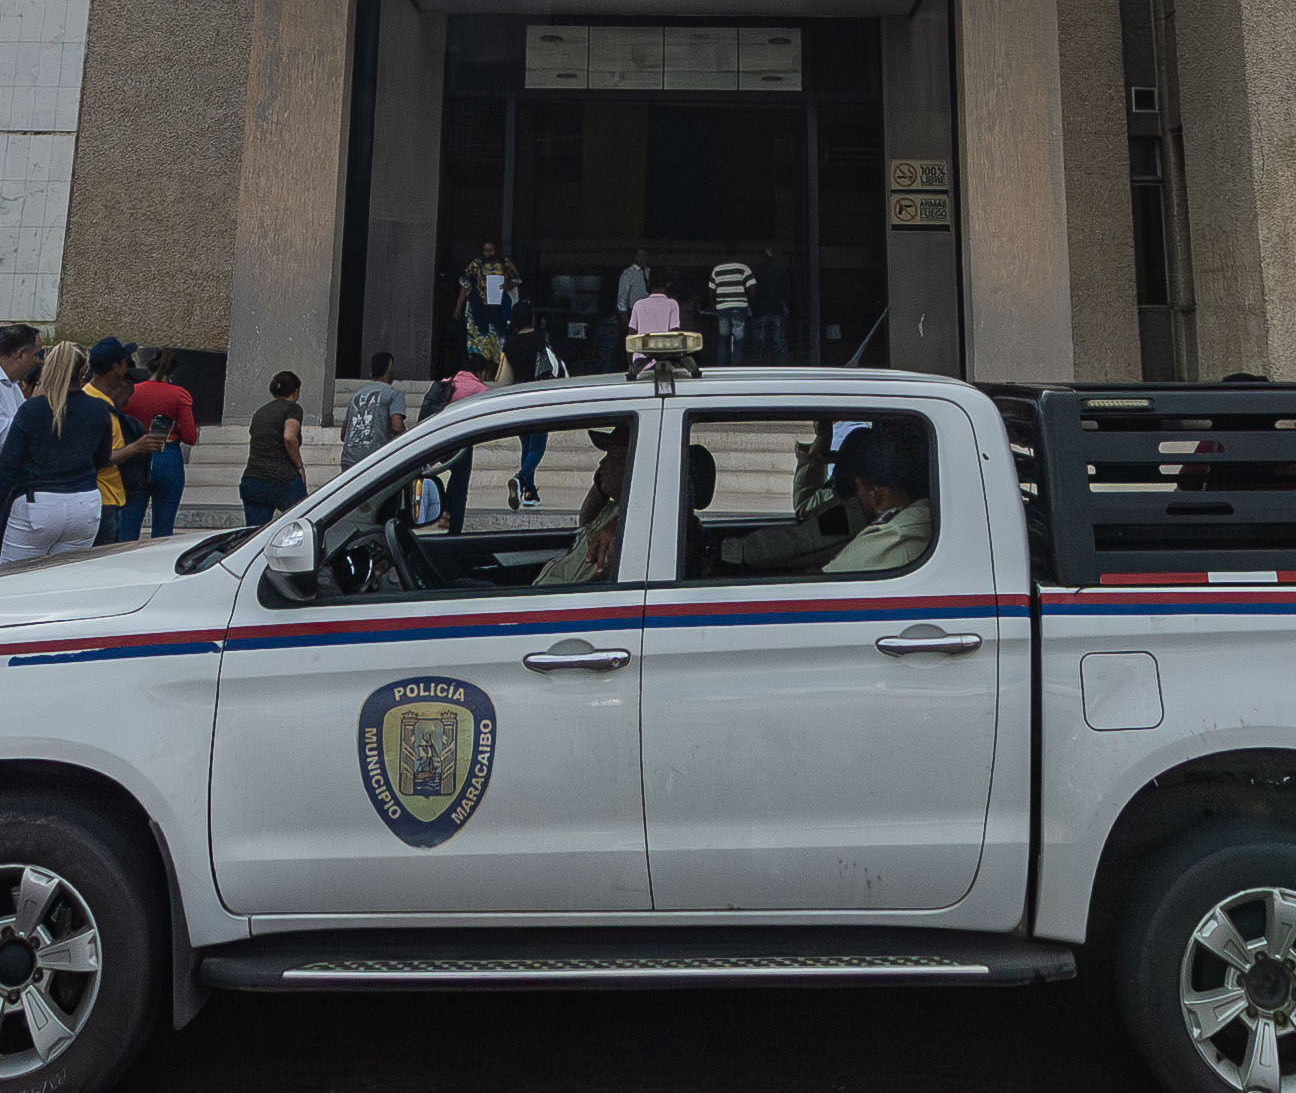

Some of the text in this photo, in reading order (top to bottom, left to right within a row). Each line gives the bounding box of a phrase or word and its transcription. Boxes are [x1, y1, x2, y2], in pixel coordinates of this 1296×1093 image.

[394, 683, 465, 702] POLICÍA
[365, 727, 401, 820] MUNICIPIO
[451, 719, 492, 824] MARACAIBO
